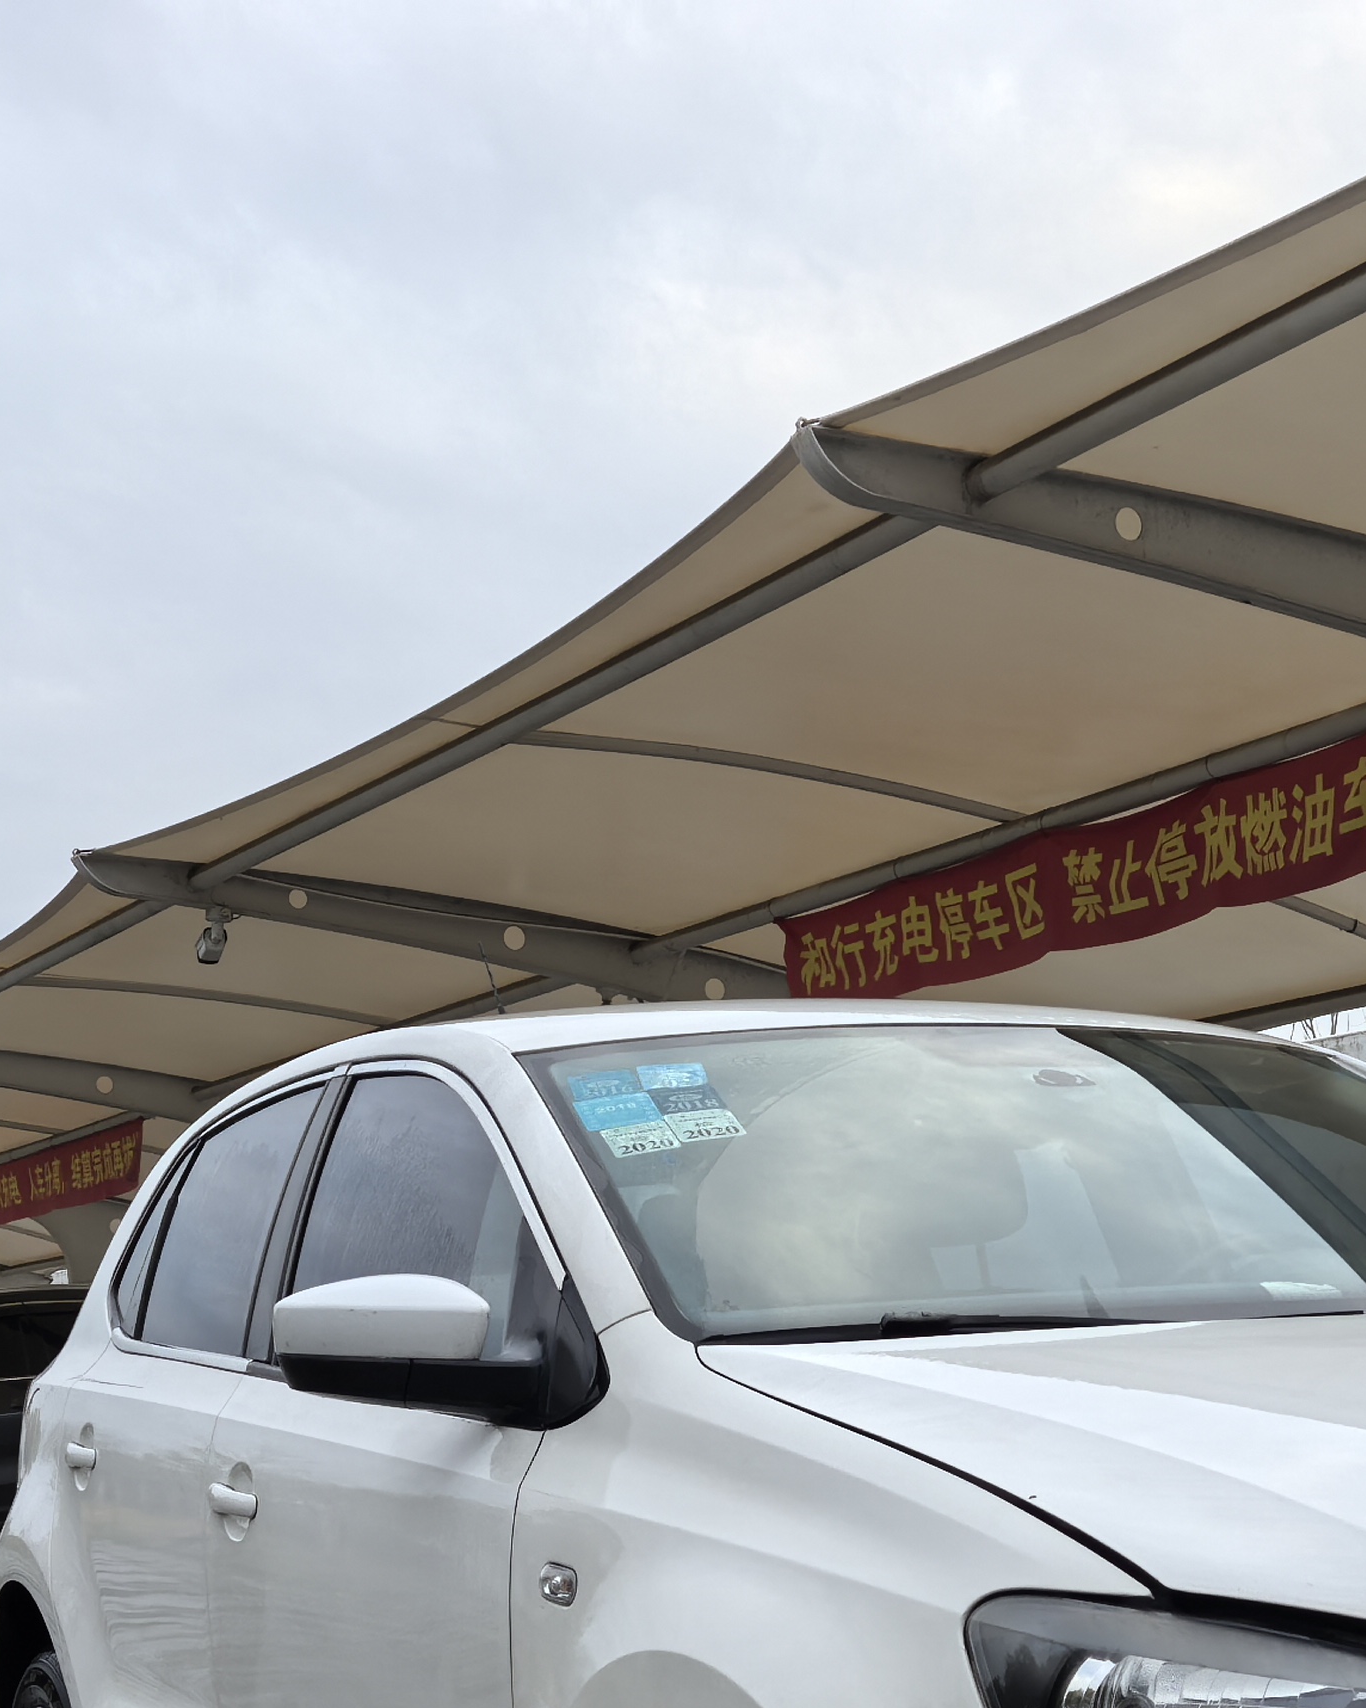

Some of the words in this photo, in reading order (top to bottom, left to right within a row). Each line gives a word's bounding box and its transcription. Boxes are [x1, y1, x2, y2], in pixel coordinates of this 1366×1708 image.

[799, 862, 1045, 996] 和行充电停车区
[663, 1098, 720, 1113] 2018
[683, 1125, 740, 1140] 2020
[617, 1139, 674, 1155] 2020
